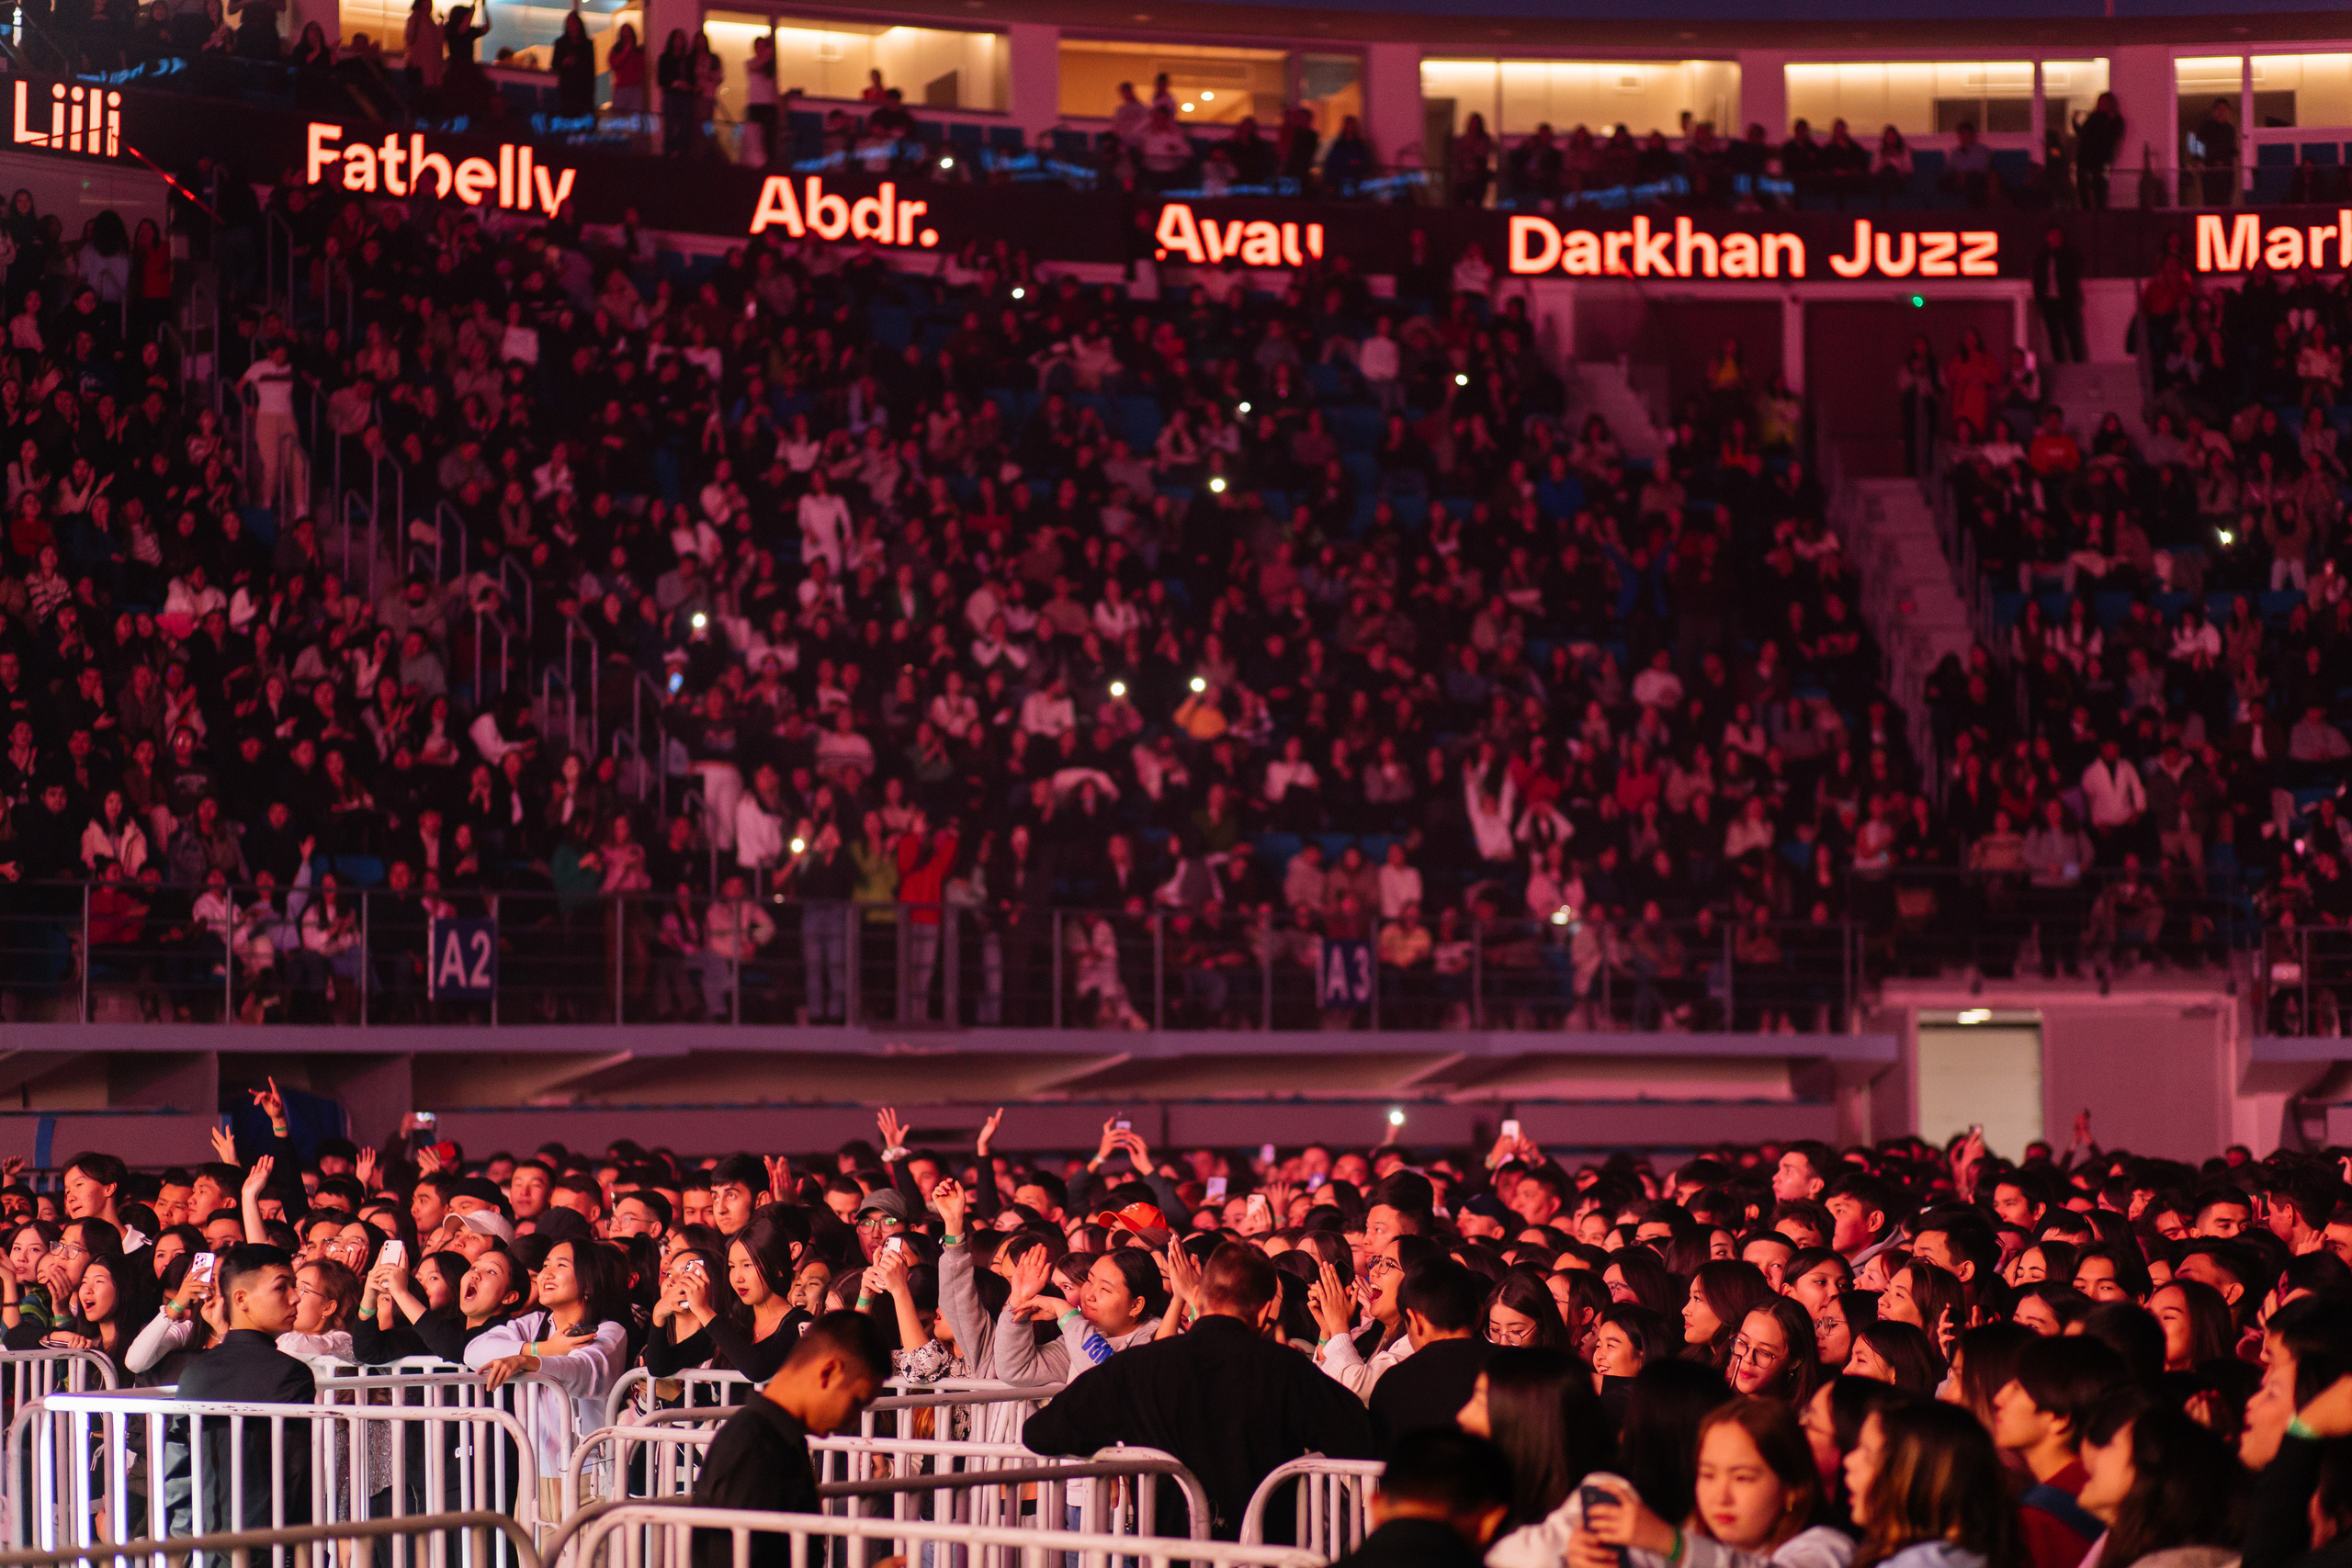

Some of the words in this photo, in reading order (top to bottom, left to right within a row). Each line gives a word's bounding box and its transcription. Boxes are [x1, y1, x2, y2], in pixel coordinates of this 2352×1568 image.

[13, 79, 121, 157] Liili
[749, 175, 940, 248] Abdr.
[1509, 215, 1806, 278] Darkhan
[1828, 219, 1998, 278] Juzz
[438, 930, 491, 988] A2
[1326, 944, 1371, 1002] A3
